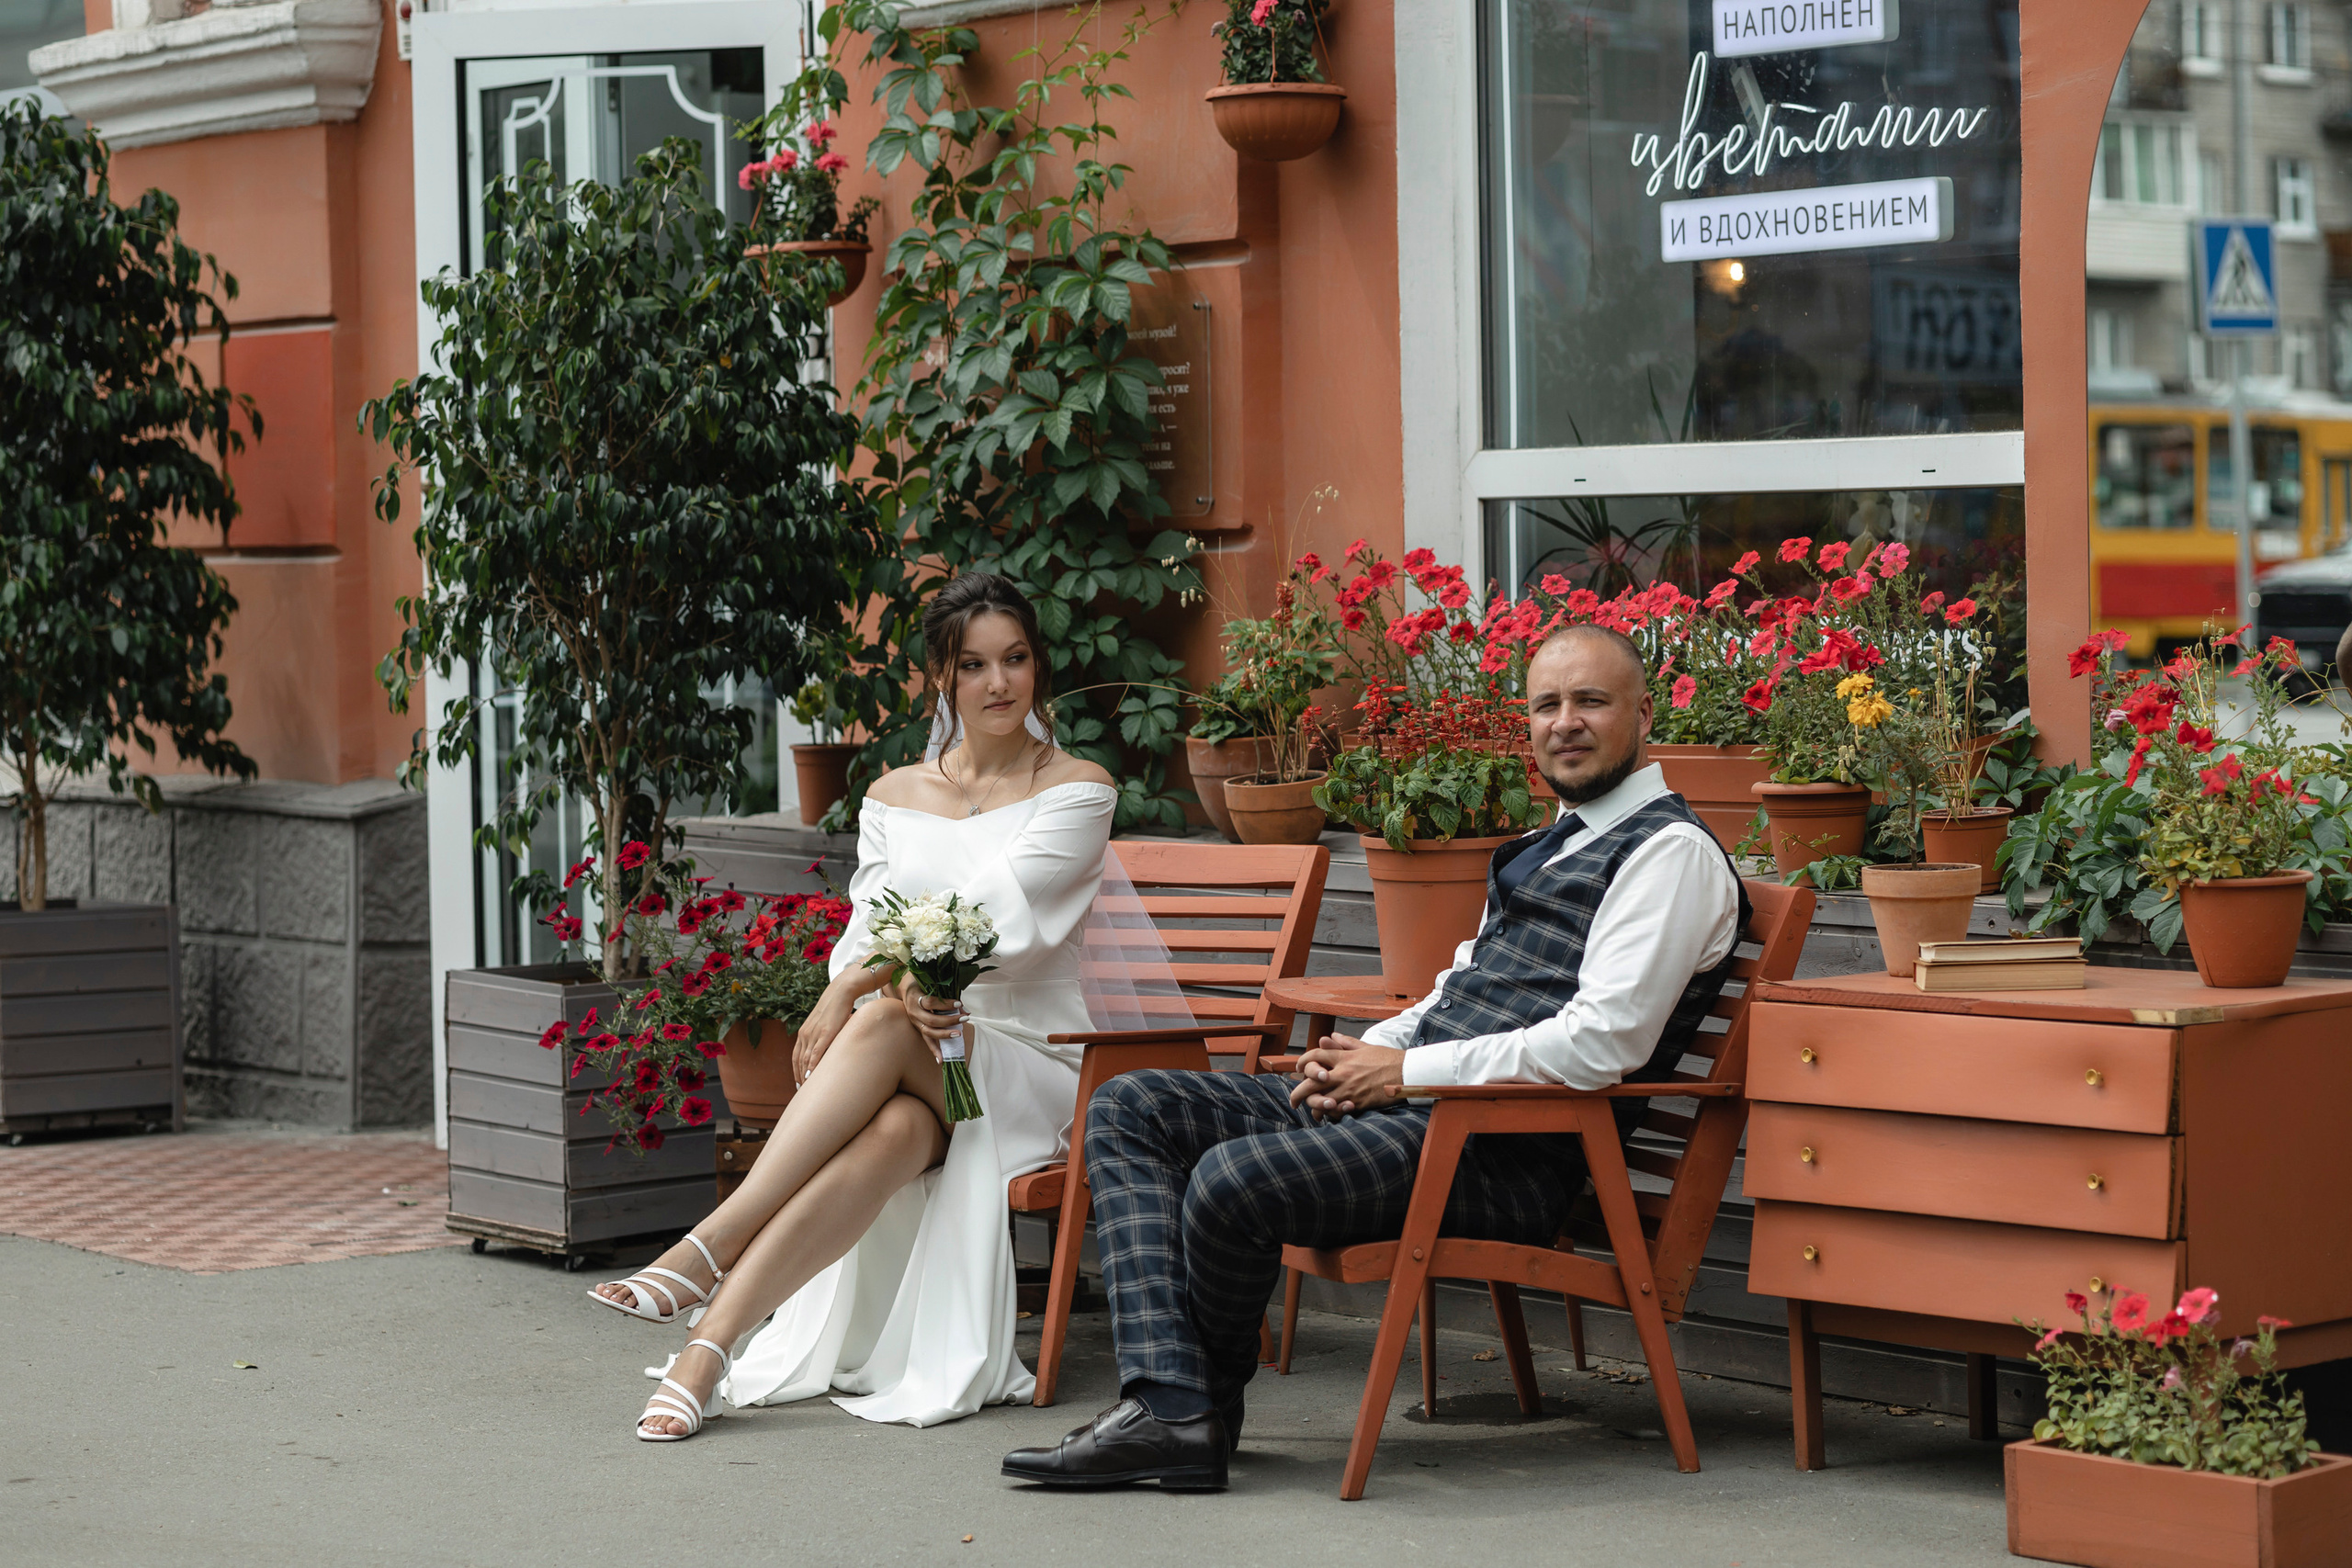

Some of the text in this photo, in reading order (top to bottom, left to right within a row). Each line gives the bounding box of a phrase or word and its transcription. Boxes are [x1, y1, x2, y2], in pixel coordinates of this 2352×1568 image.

[1724, 0, 1872, 39] НАПОЛНЕН
[1631, 51, 1989, 197] цветами
[1671, 195, 1928, 246] И ВДОХНОВЕНИЕМ
